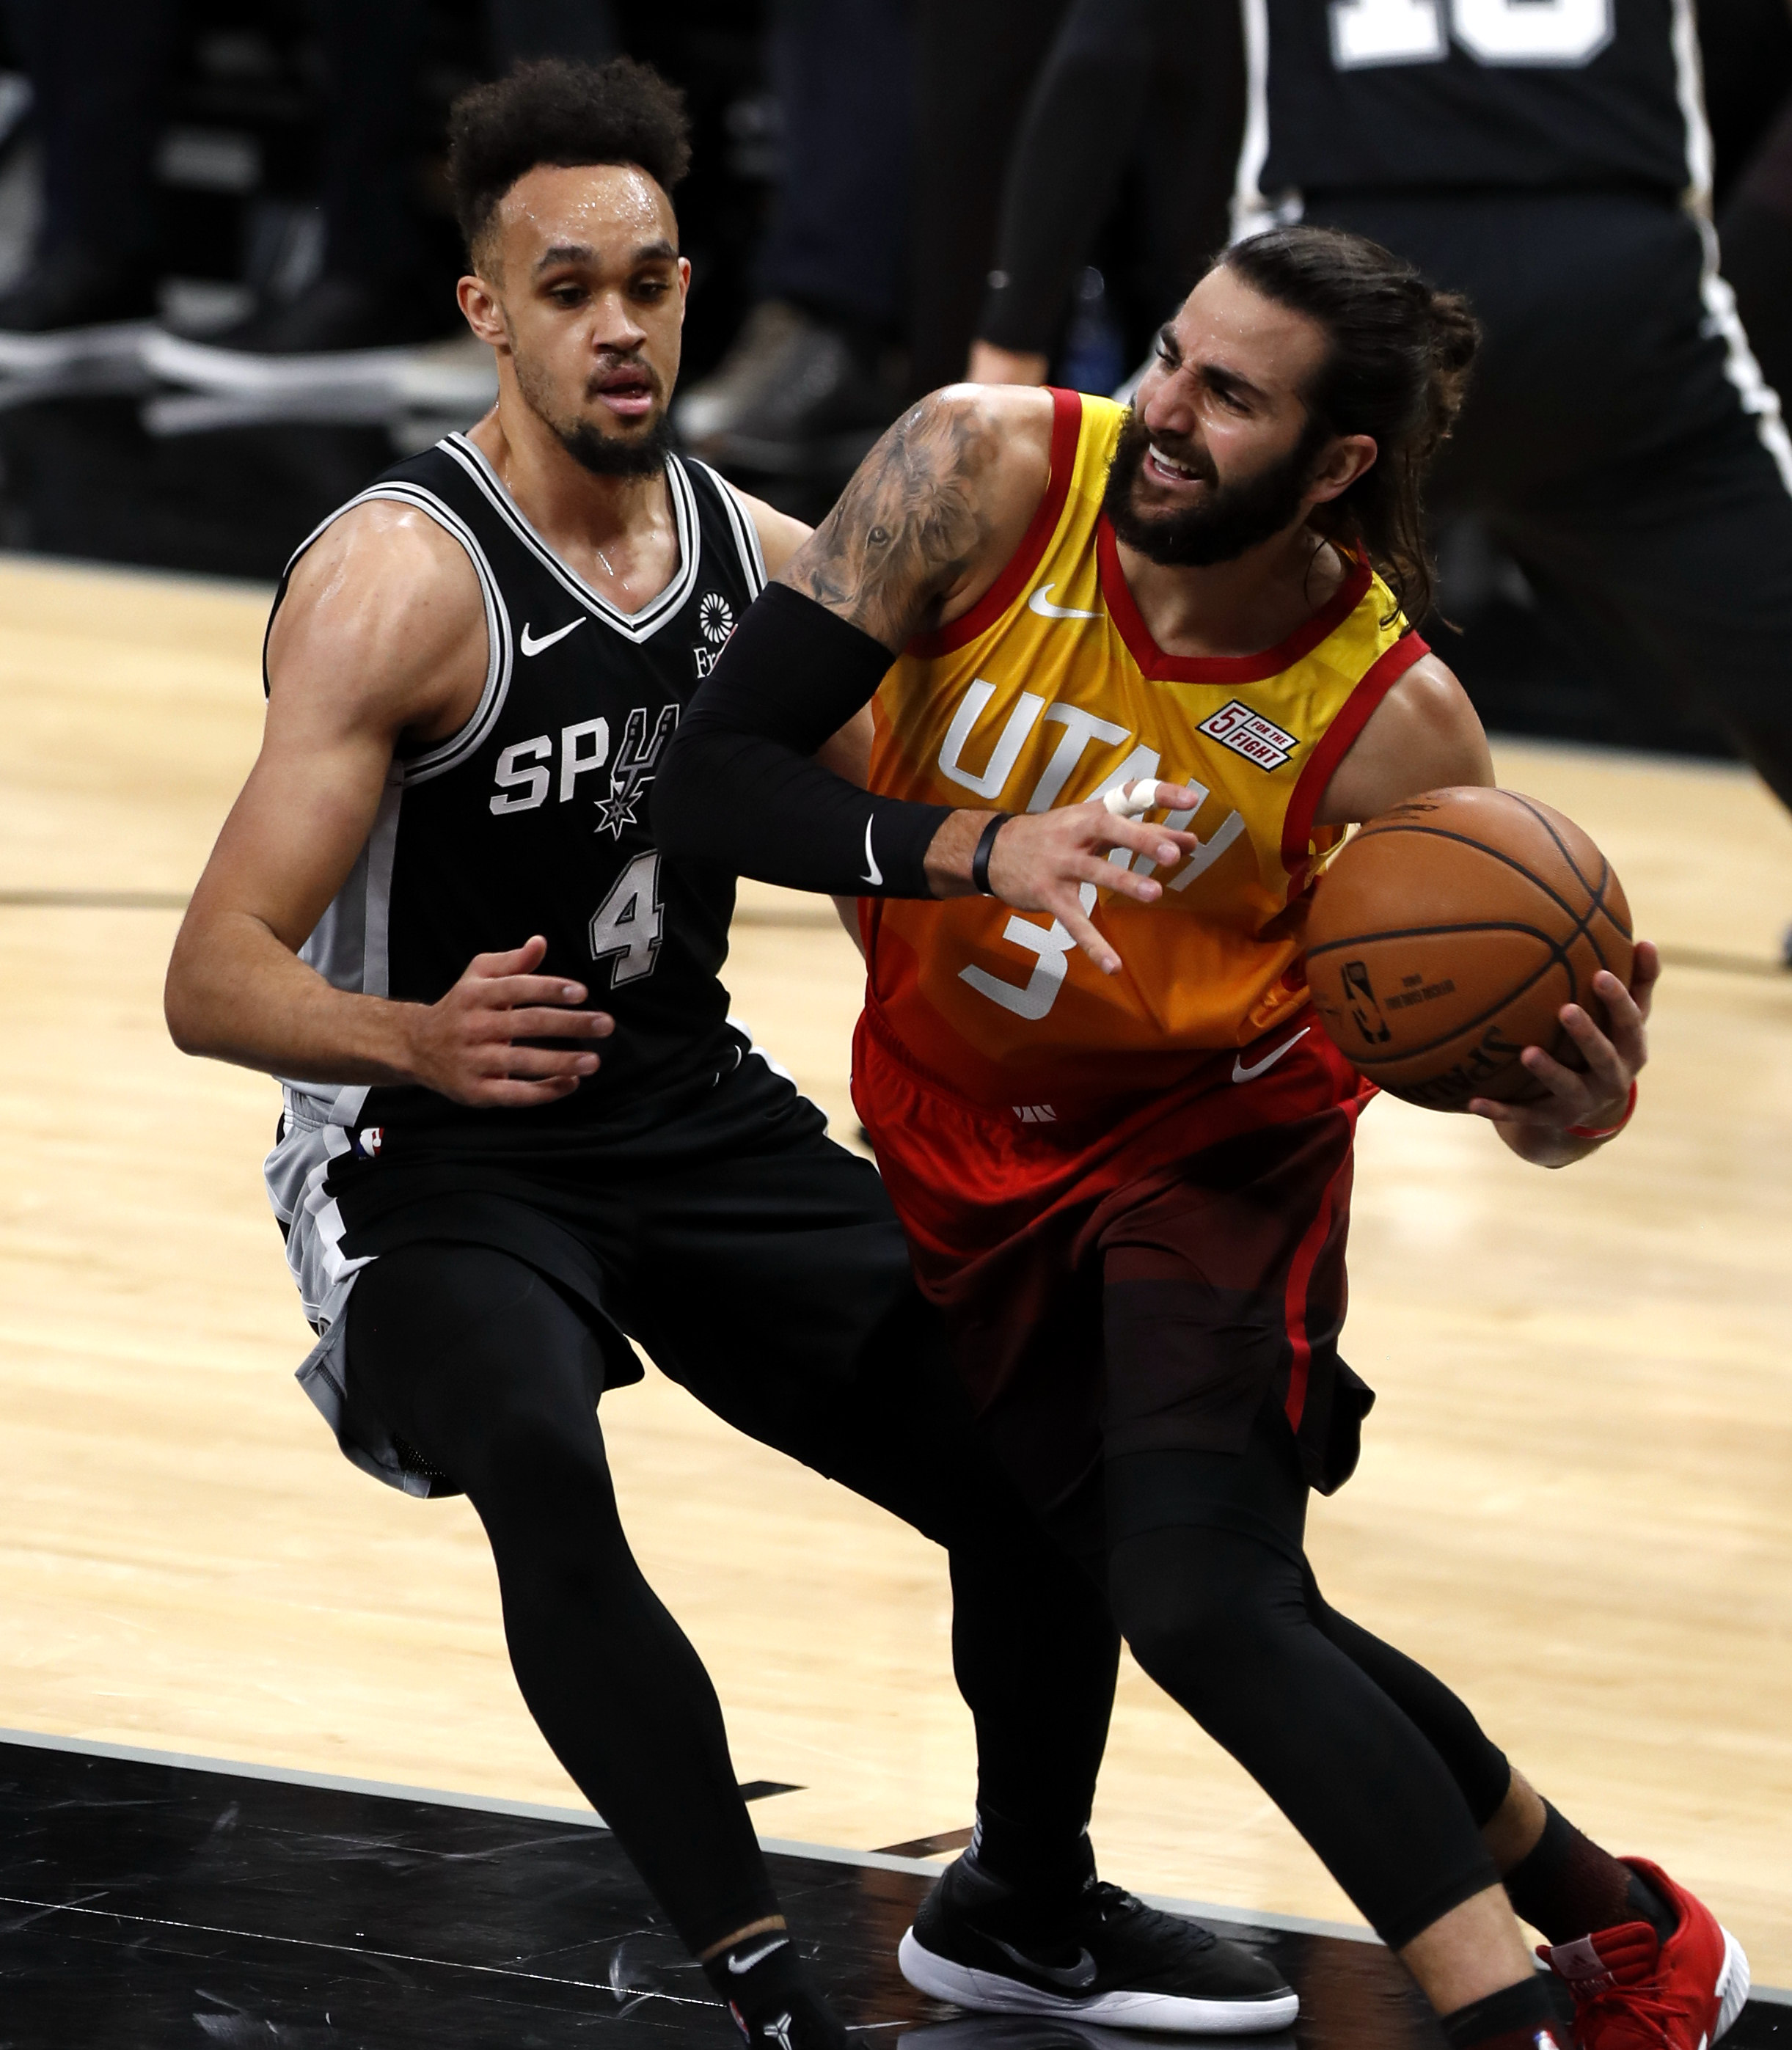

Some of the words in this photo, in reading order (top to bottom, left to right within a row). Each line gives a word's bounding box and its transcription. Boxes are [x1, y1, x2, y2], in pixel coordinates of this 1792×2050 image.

[489, 704, 681, 841] SPU
[938, 677, 1246, 893] UTAH
[1209, 706, 1246, 734] 5
[1229, 731, 1281, 764] FIGHT
[1251, 720, 1272, 735] FOR
[1268, 731, 1289, 746] THE
[588, 847, 665, 990] 4
[957, 882, 1097, 1021] 3
